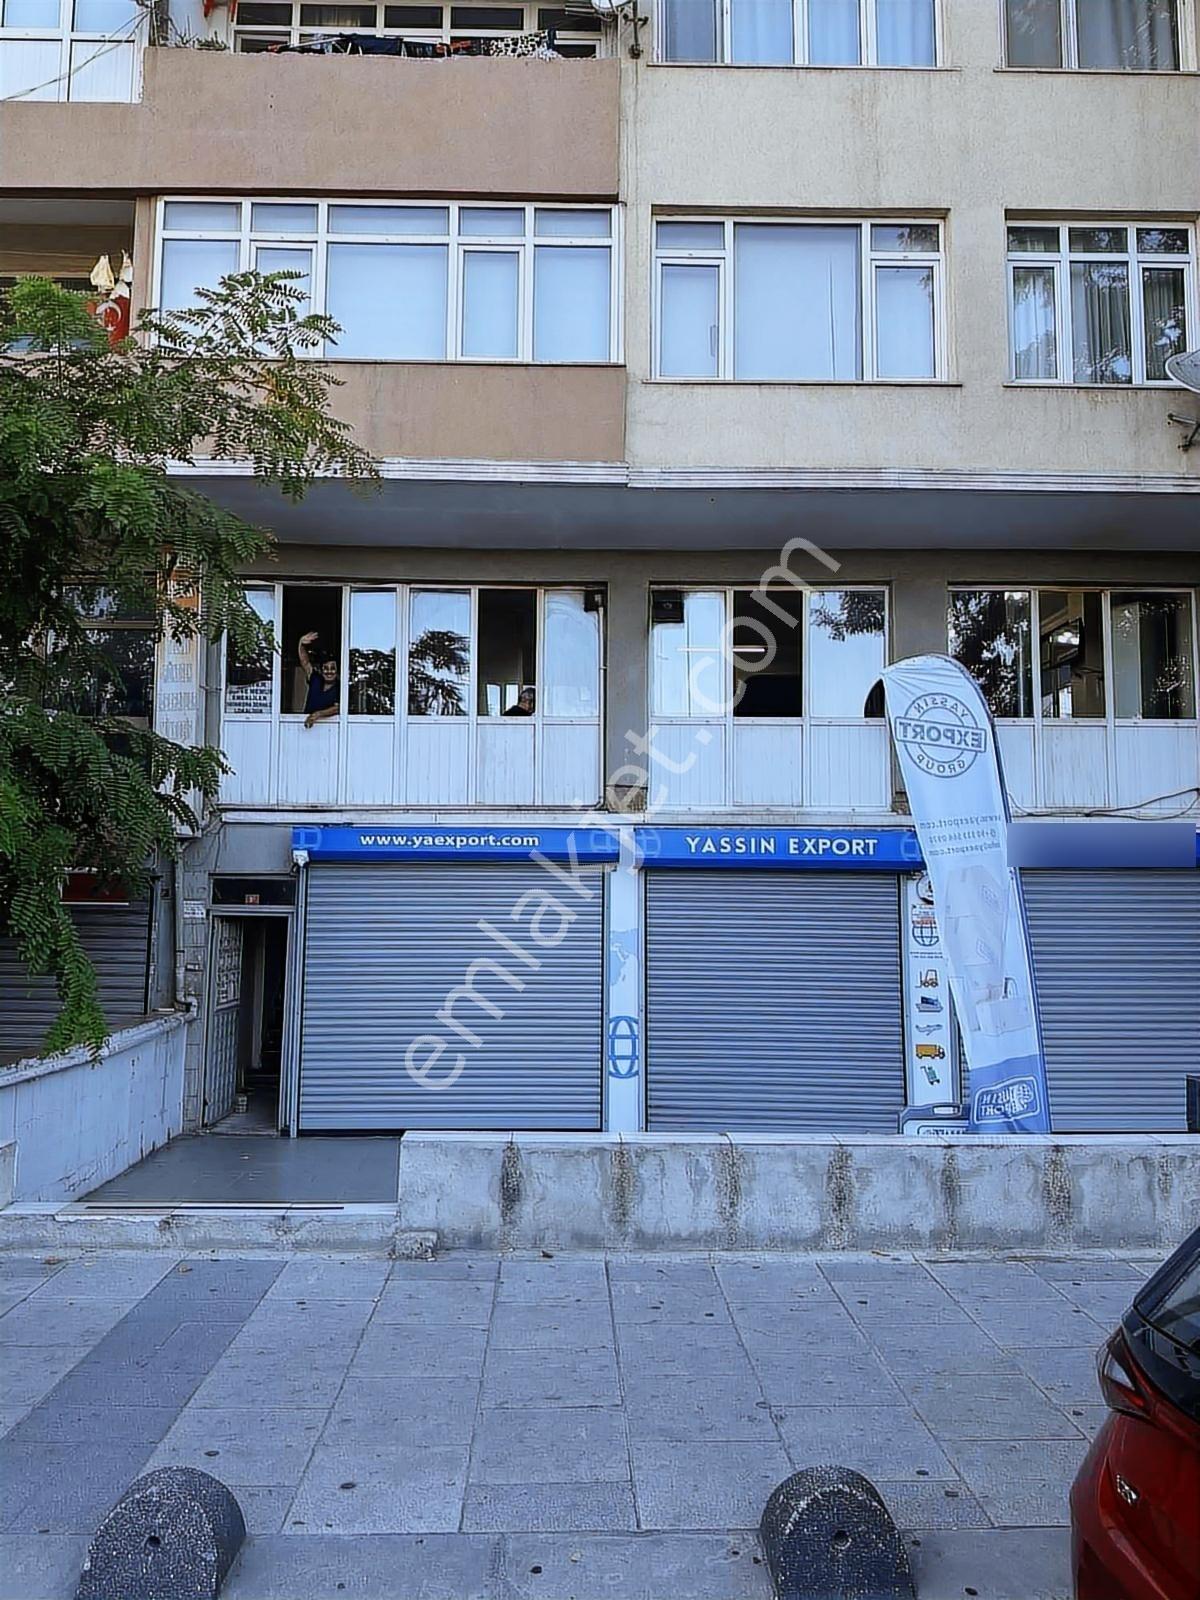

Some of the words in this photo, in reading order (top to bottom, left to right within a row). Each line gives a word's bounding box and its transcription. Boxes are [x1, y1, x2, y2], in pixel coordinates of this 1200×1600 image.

[359, 832, 540, 849] www.yaexport.com
[685, 836, 776, 855] YASSIN
[788, 836, 878, 856] EXPORT
